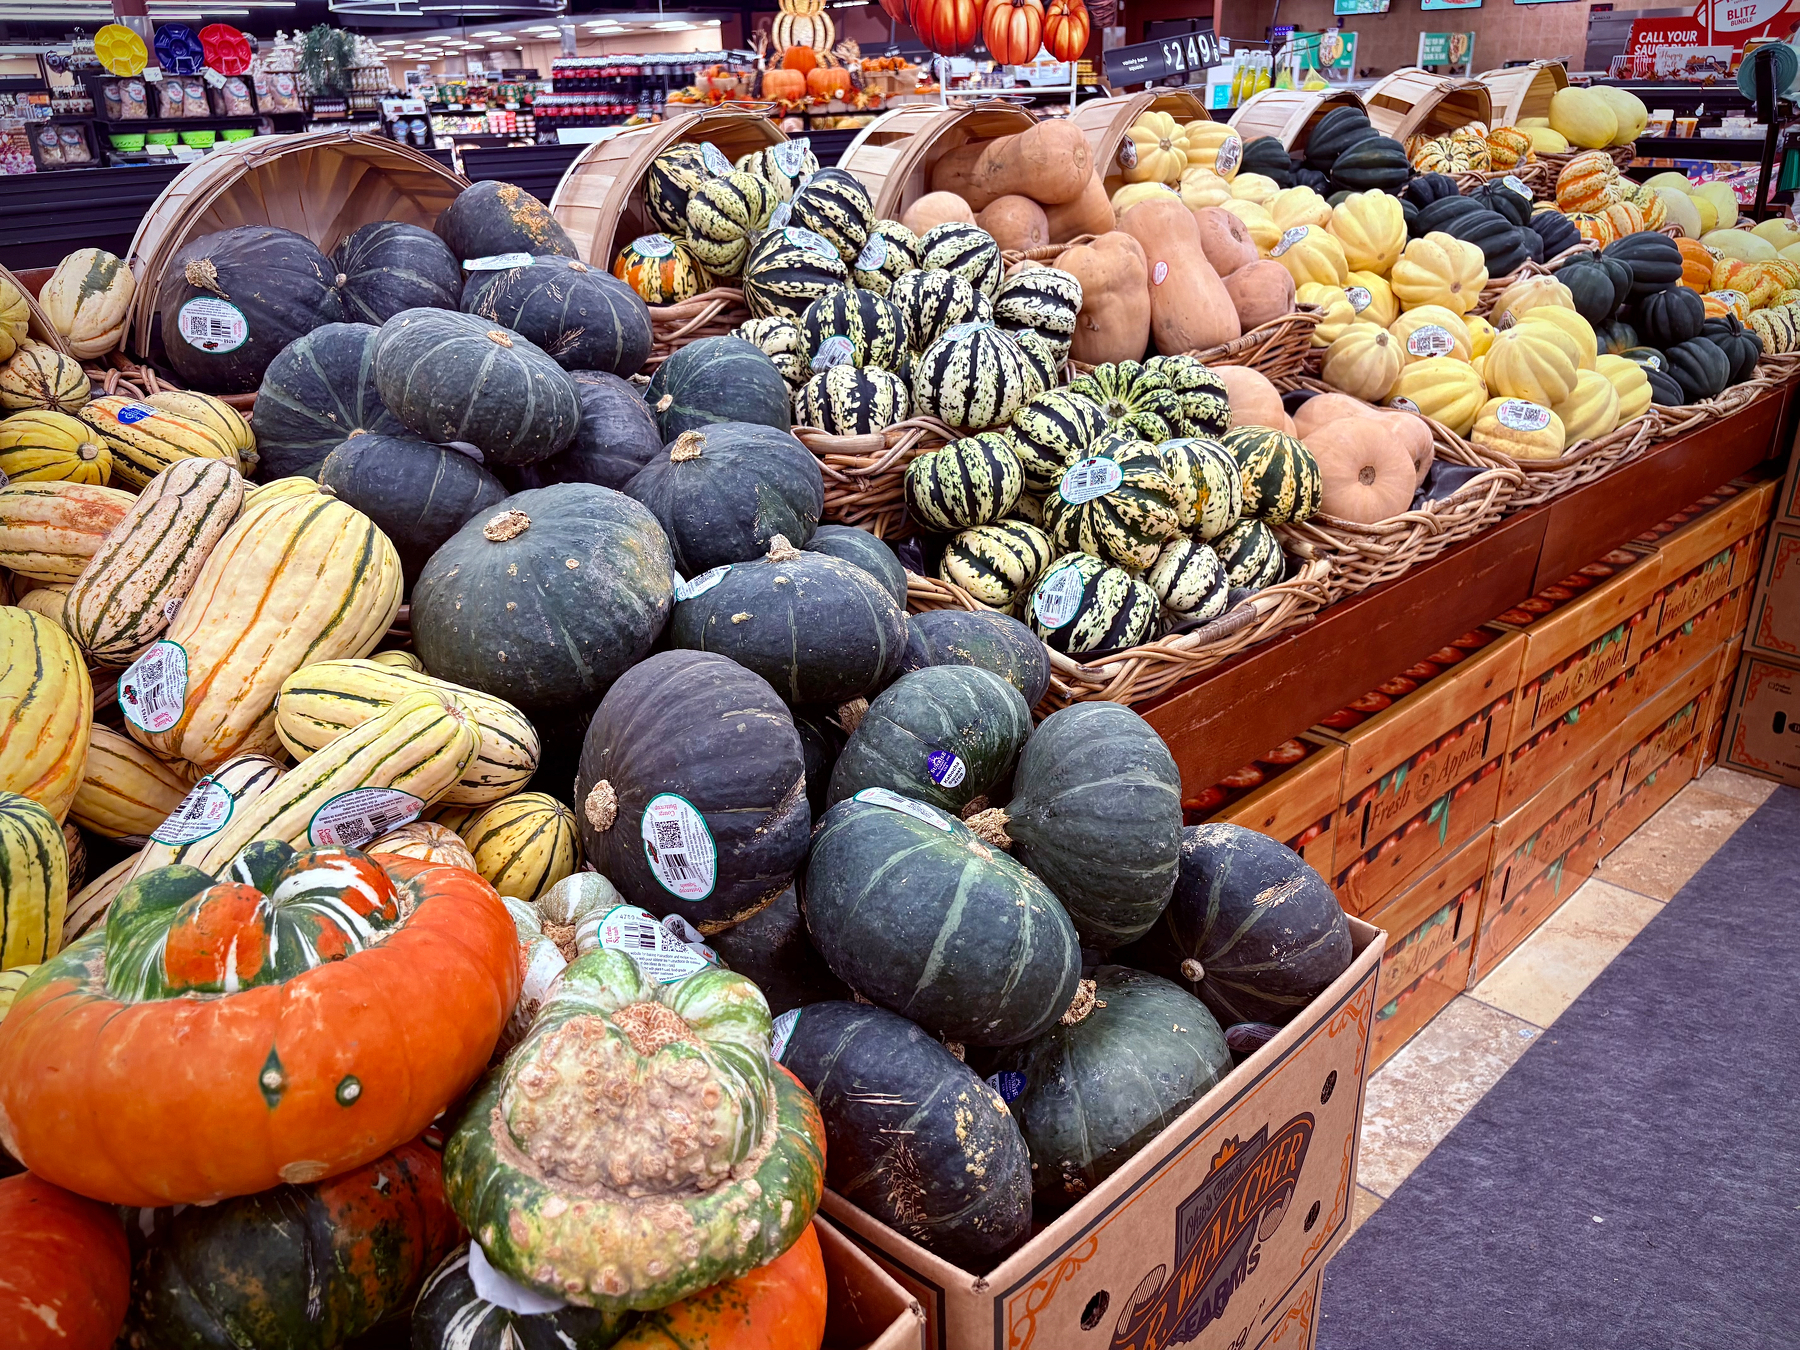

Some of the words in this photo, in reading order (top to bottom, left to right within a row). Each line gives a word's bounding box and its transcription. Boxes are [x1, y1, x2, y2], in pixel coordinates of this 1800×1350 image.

[1727, 4, 1757, 20] BLITZ
[1730, 17, 1754, 26] BUNDLE
[1638, 31, 1664, 43] CALL
[1667, 30, 1698, 43] YOUR
[1121, 57, 1138, 66] variety
[1163, 34, 1211, 71] $2.49
[1660, 50, 1684, 60] Happy
[1128, 64, 1145, 72] squash
[1537, 677, 1569, 719] Fresh
[1587, 643, 1624, 687] Apples
[944, 762, 960, 784] Kabocha
[948, 767, 962, 784] Squash
[1368, 780, 1411, 832] Fresh
[1435, 734, 1484, 785] Apples
[612, 926, 620, 944] Squash
[1404, 926, 1453, 975] Apples
[1184, 1194, 1214, 1245] Ohio's
[1212, 1160, 1244, 1201] Finest
[1176, 1132, 1304, 1316] WALCHER
[1185, 1243, 1262, 1330] FARMS
